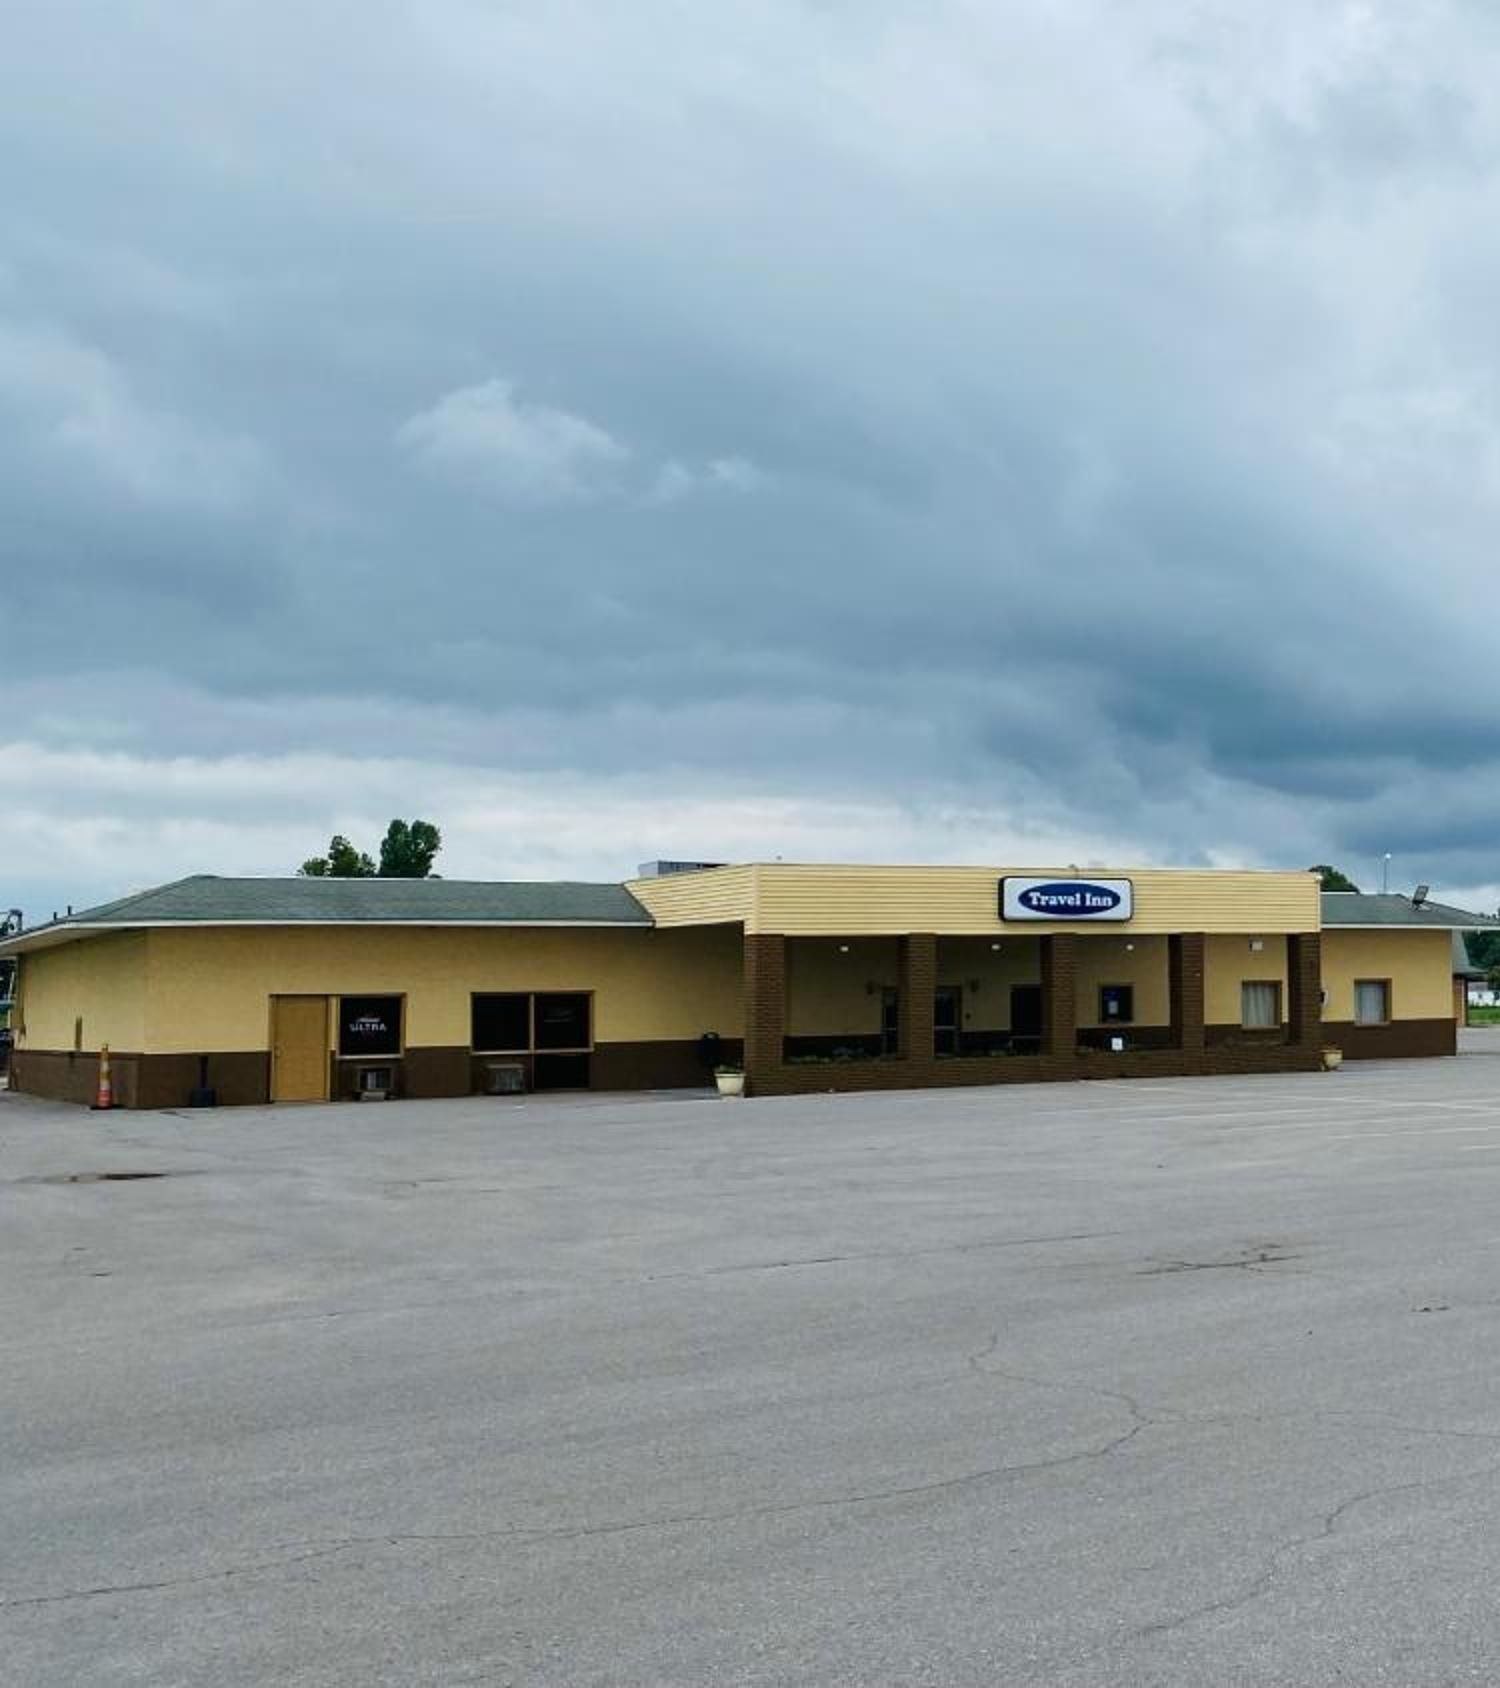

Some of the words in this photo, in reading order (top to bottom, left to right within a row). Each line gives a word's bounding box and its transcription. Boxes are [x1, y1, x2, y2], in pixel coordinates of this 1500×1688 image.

[1029, 891, 1081, 906] Travel
[1085, 892, 1113, 907] Inn
[349, 1023, 387, 1032] ULTRA
